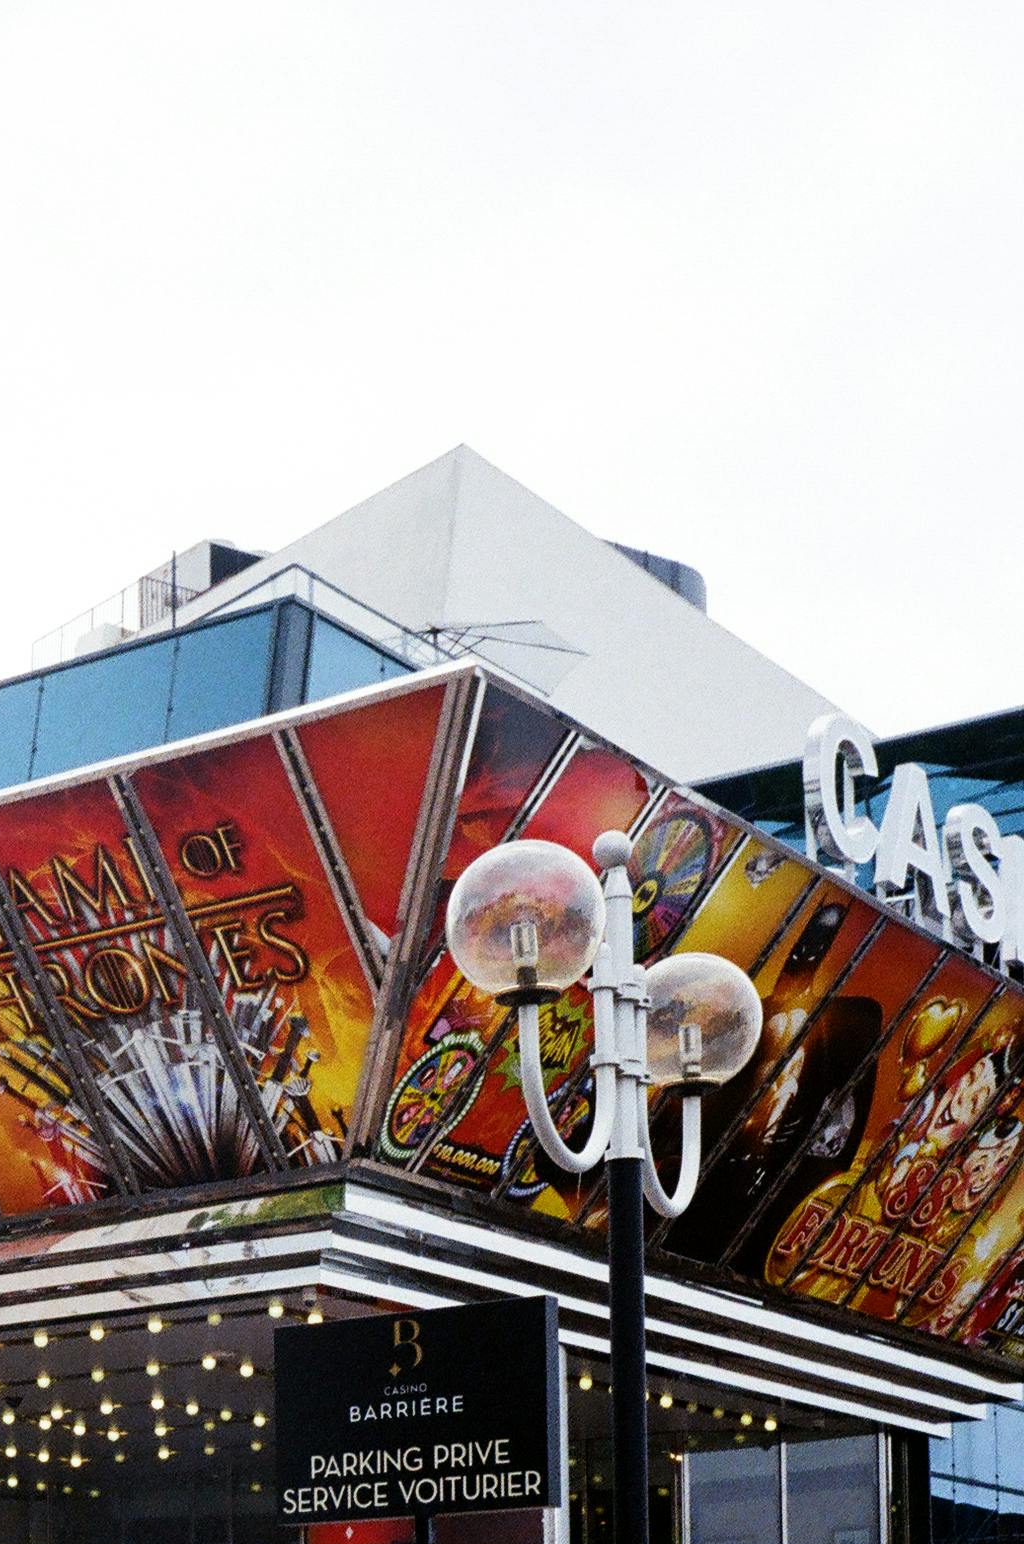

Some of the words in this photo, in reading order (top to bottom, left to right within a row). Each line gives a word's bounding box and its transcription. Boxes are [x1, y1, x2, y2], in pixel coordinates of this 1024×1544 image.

[181, 823, 243, 877] OF
[885, 1159, 961, 1228] 88
[777, 1200, 969, 1304] FORTUNS
[384, 1382, 428, 1397] CASINO
[311, 1446, 424, 1479] PARKING
[433, 1438, 511, 1470] PRIVE
[282, 1481, 389, 1514] SERVICE
[398, 1470, 542, 1504] VOITURIER
